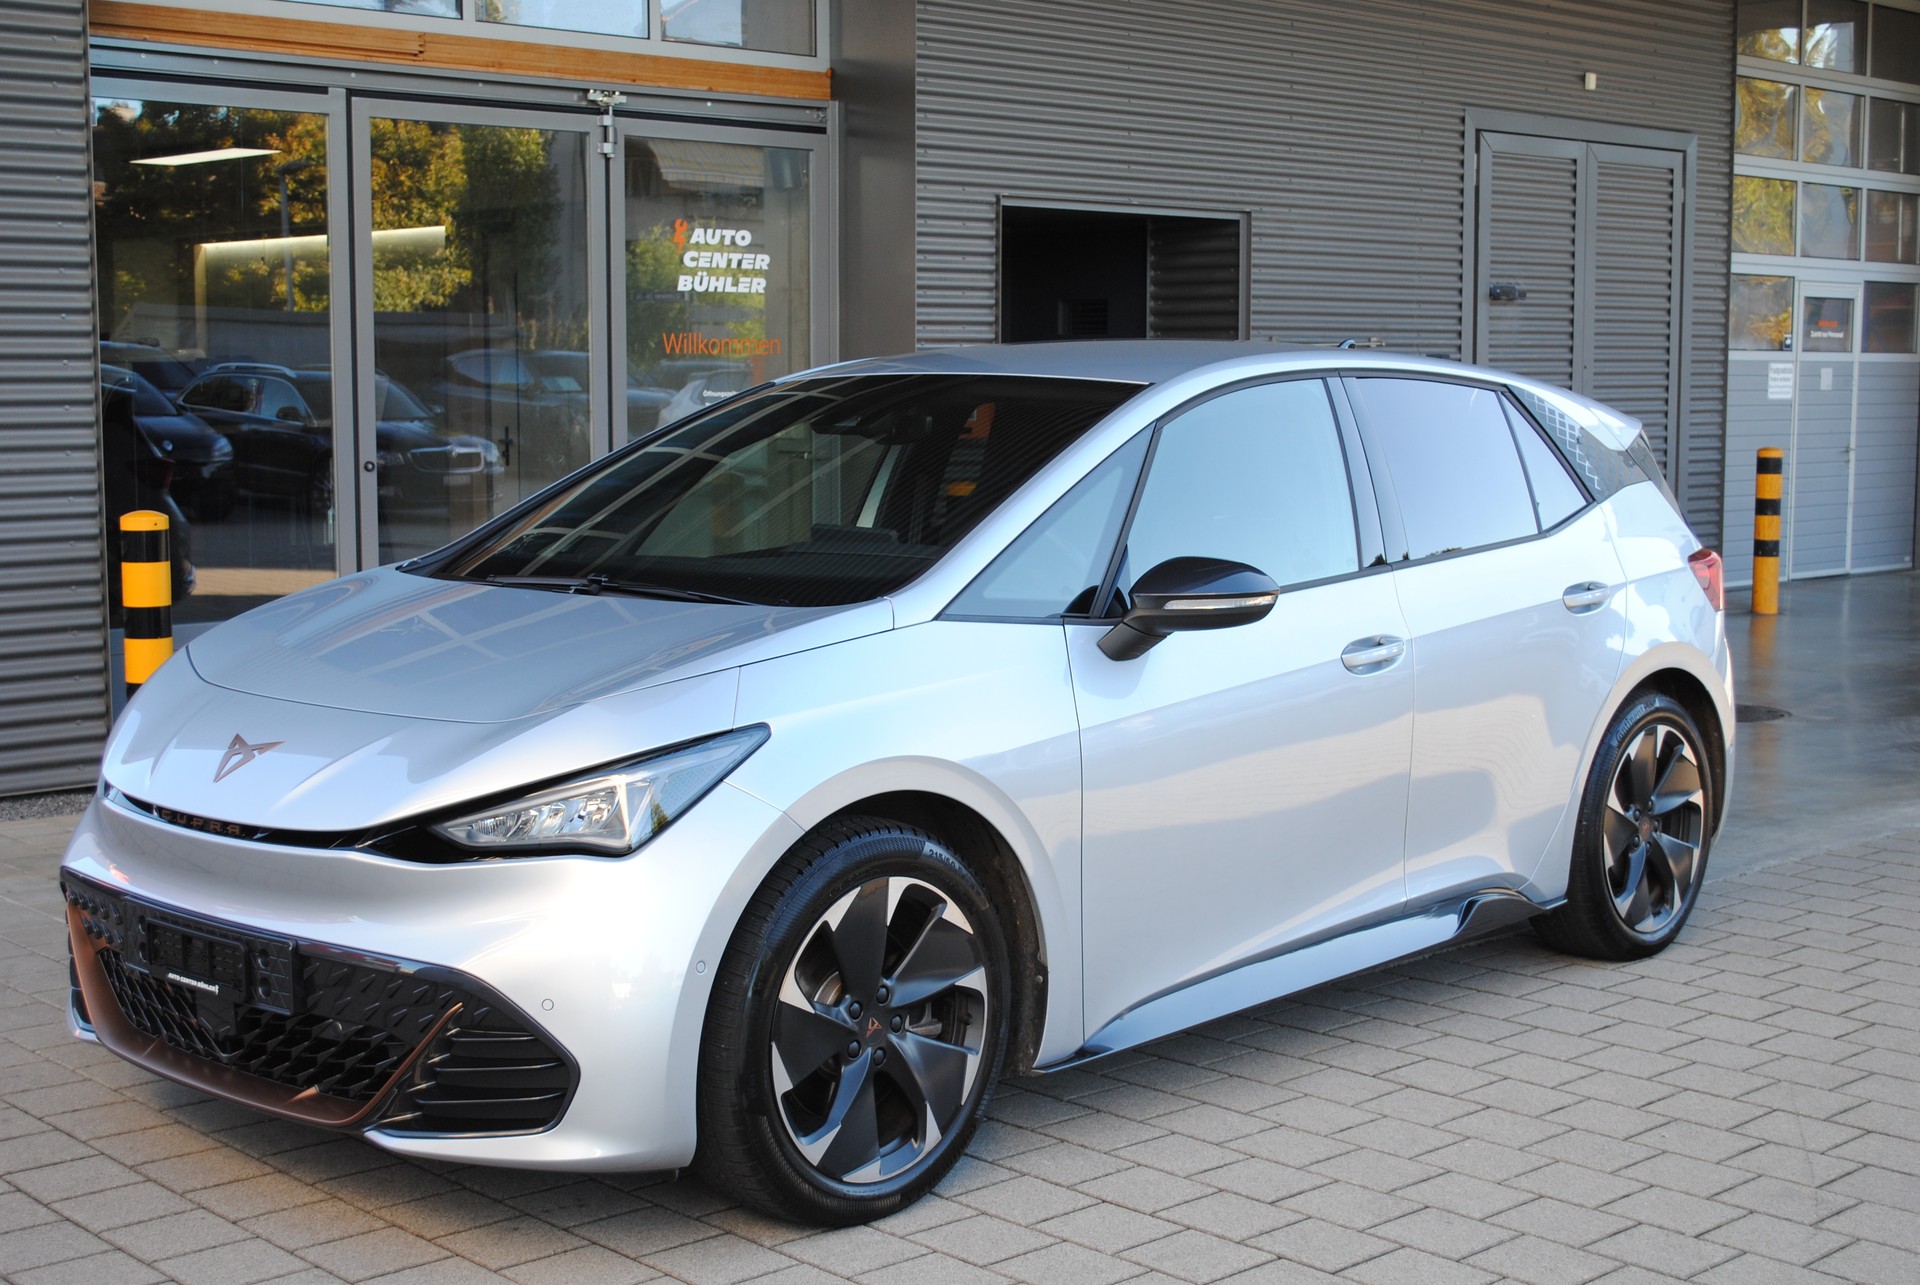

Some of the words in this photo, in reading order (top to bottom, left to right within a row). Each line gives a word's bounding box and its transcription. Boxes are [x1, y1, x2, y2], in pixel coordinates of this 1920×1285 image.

[690, 227, 752, 247] AUTO
[683, 251, 771, 270] CENTER
[677, 271, 767, 293] BÜHLER
[662, 332, 782, 355] Willkommen
[161, 808, 241, 836] CUPRA
[168, 972, 181, 981] AUTO
[180, 976, 198, 986] CENTER
[197, 981, 217, 992] BÜHLER
